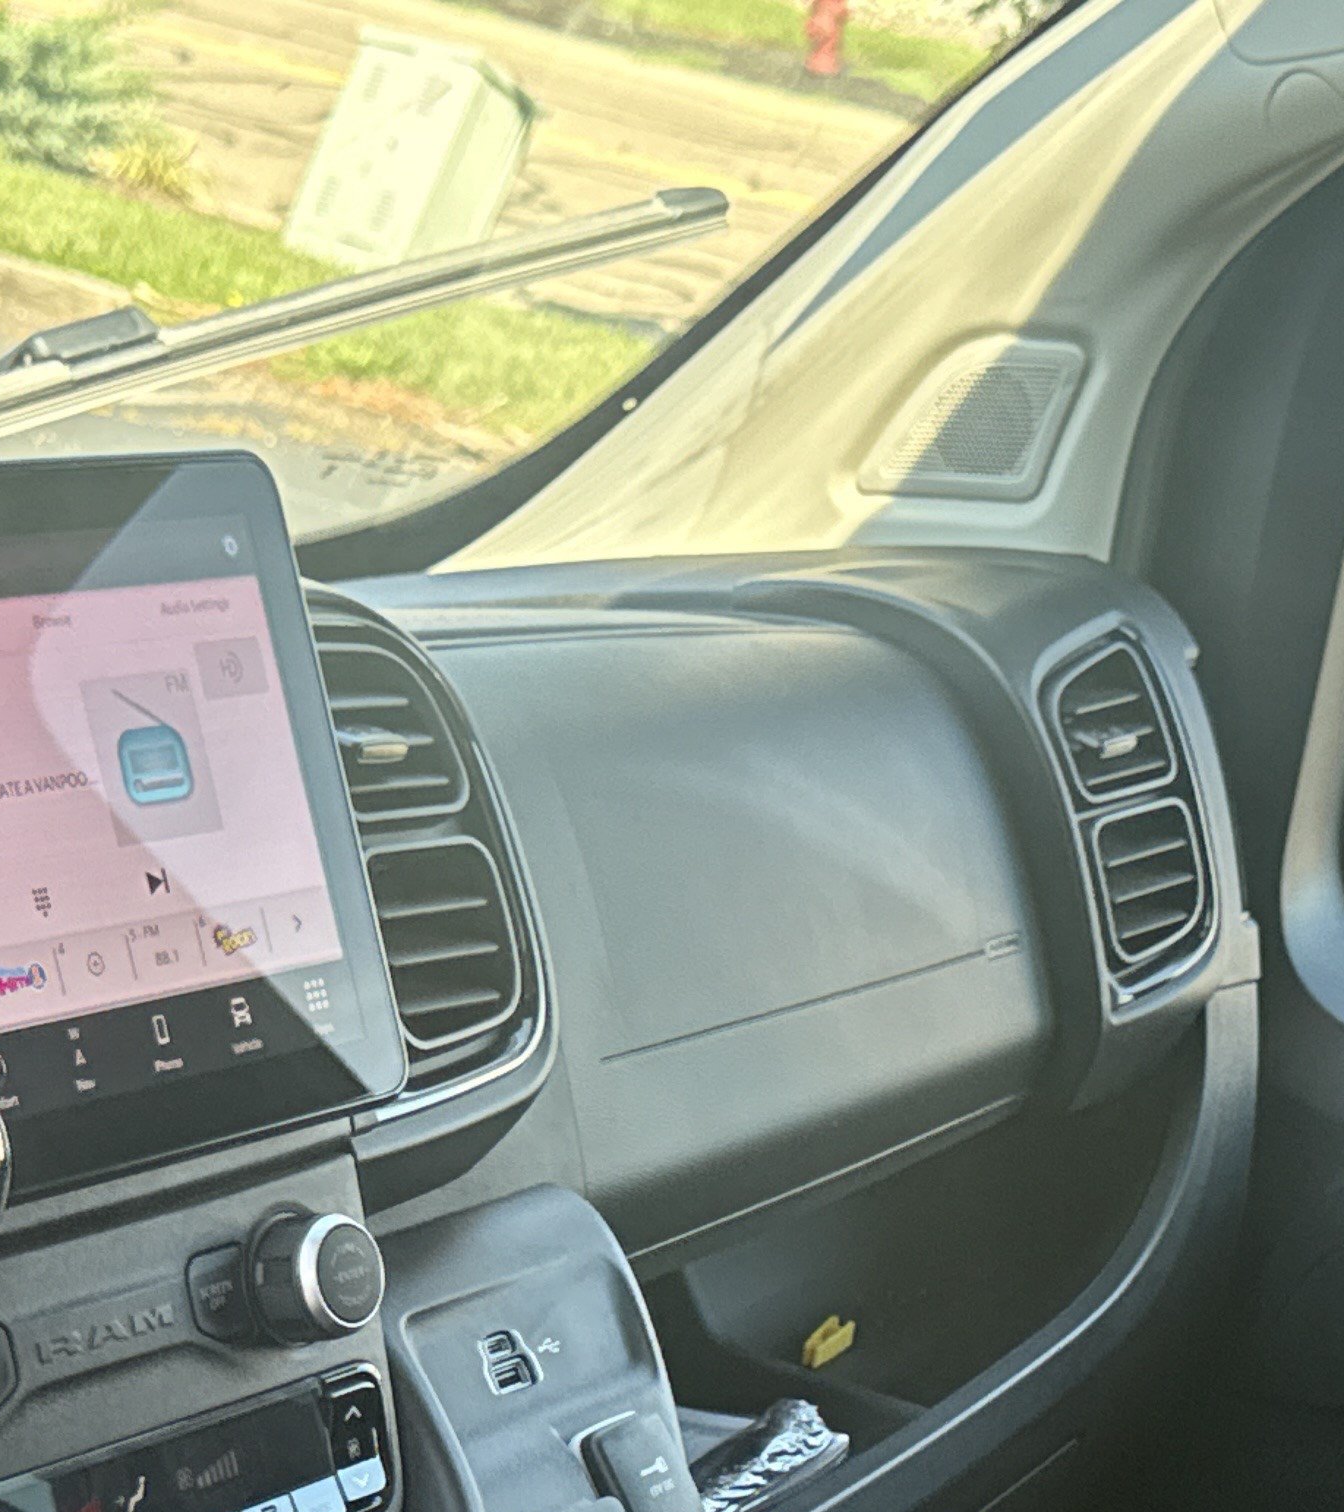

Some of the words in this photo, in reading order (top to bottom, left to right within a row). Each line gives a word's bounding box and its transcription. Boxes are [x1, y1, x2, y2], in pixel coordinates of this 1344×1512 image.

[164, 673, 190, 694] FM
[24, 779, 34, 795] A
[155, 949, 180, 967] 88.1
[34, 1303, 176, 1366] RAM
